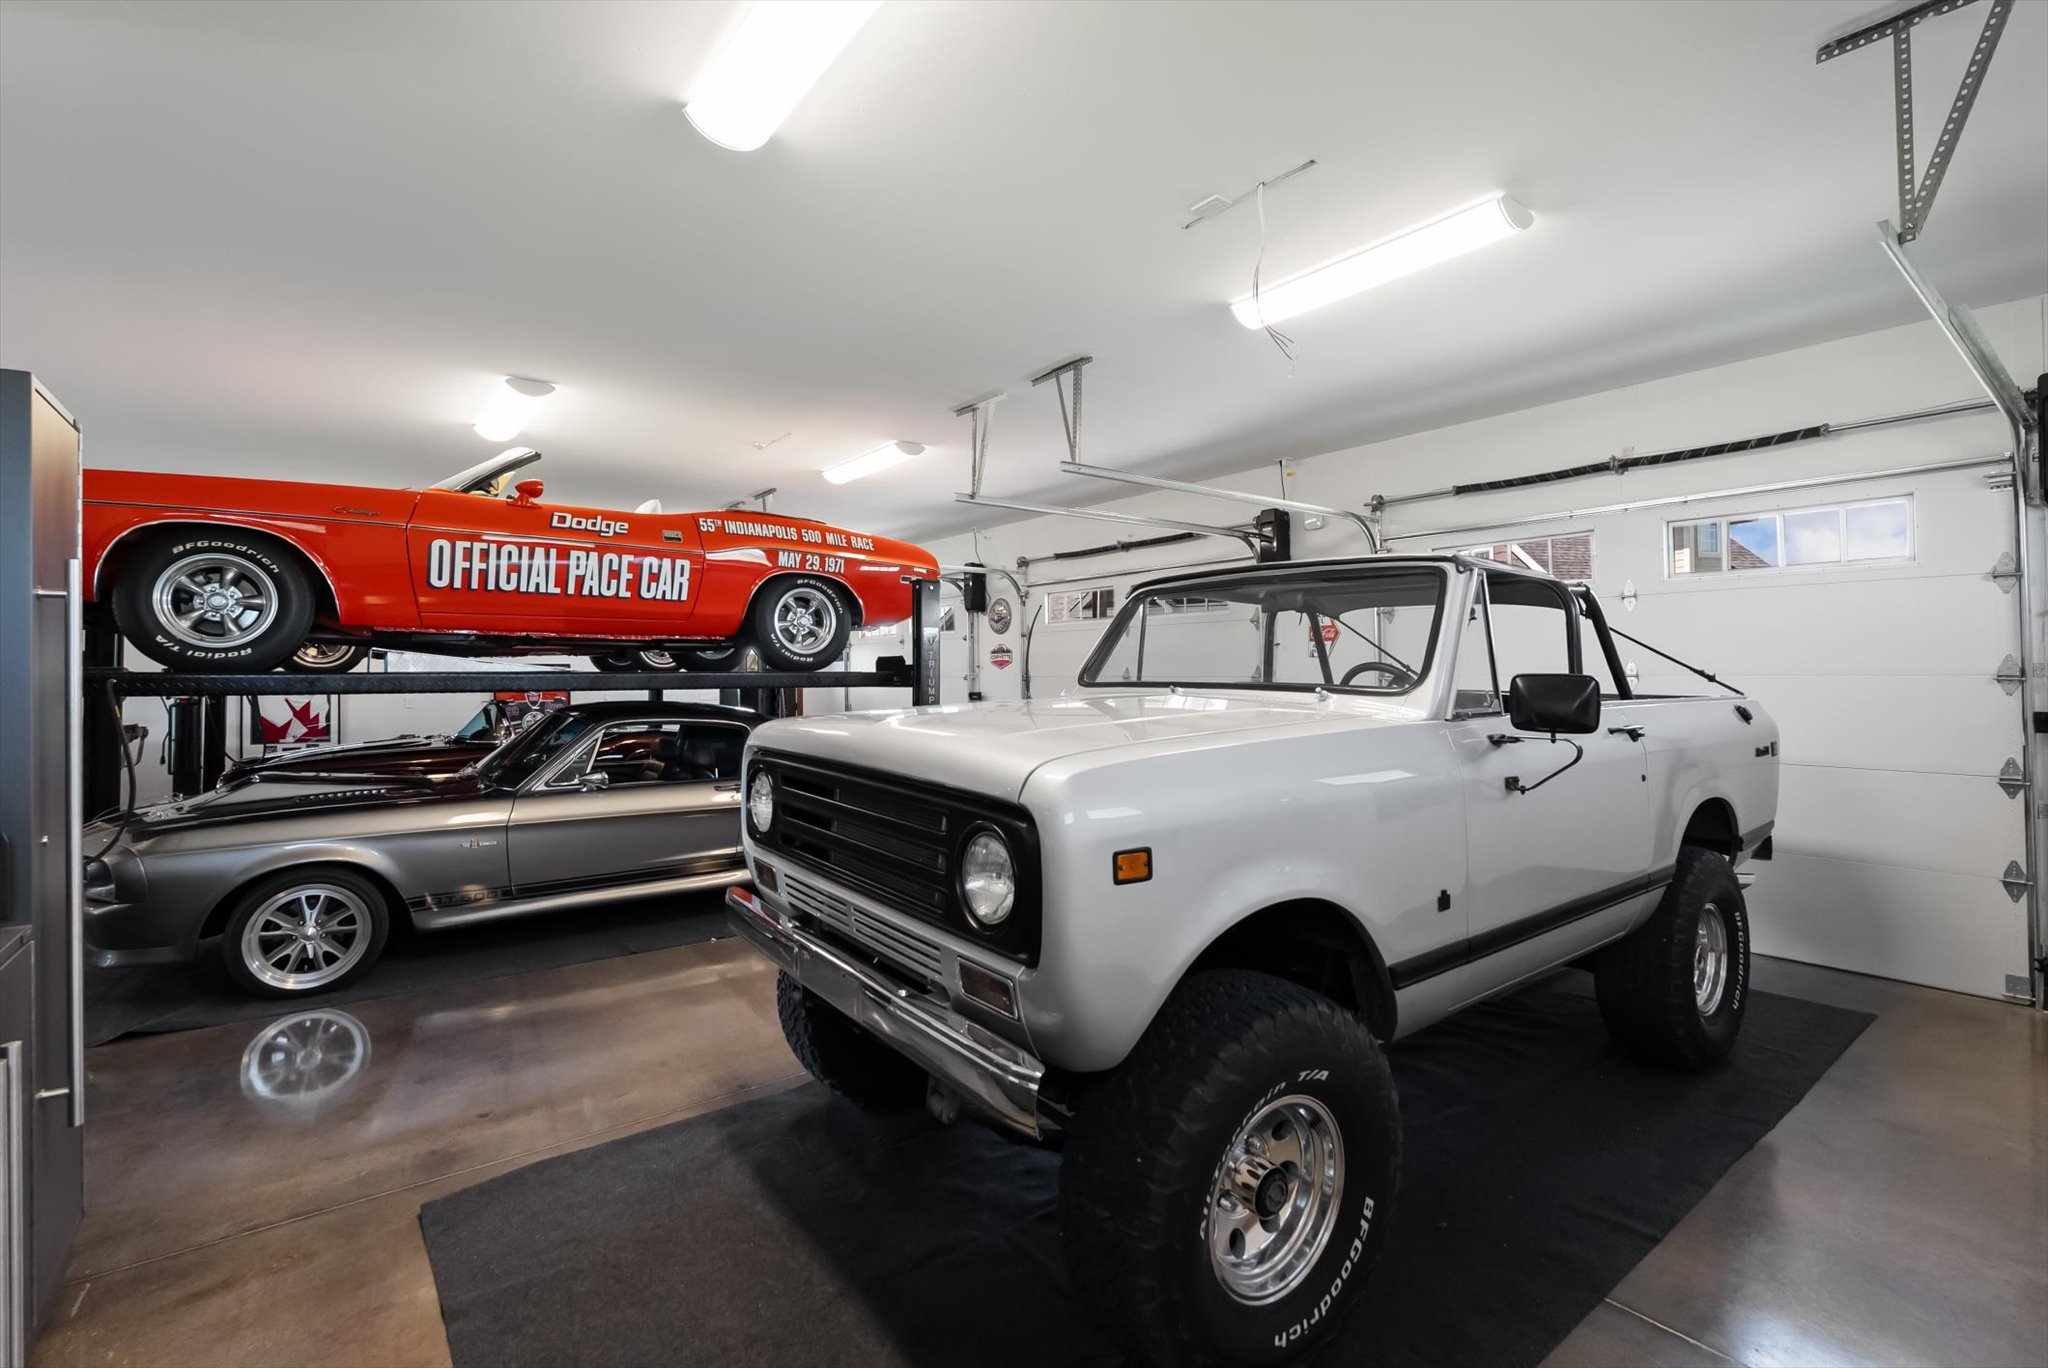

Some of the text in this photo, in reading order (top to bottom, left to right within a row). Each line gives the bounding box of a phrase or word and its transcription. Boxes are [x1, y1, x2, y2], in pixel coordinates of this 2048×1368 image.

[550, 512, 629, 536] Dodge
[723, 520, 798, 541] INDIANAPOLIS
[801, 530, 821, 544] 500
[825, 532, 848, 547] MILE
[850, 535, 875, 551] RACE
[172, 540, 280, 573] BFGoodrich
[428, 538, 691, 602] OFFICIAL PACE CAR
[778, 551, 802, 568] MAY
[824, 557, 845, 574] 1971
[796, 578, 844, 614] BFGoodrich
[154, 634, 253, 660] Radial T/A
[782, 648, 814, 662] Radial
[1732, 911, 1745, 1010] BFGoodrich
[1297, 1068, 1330, 1082] T/A
[1274, 1196, 1375, 1348] BFGoodrich
